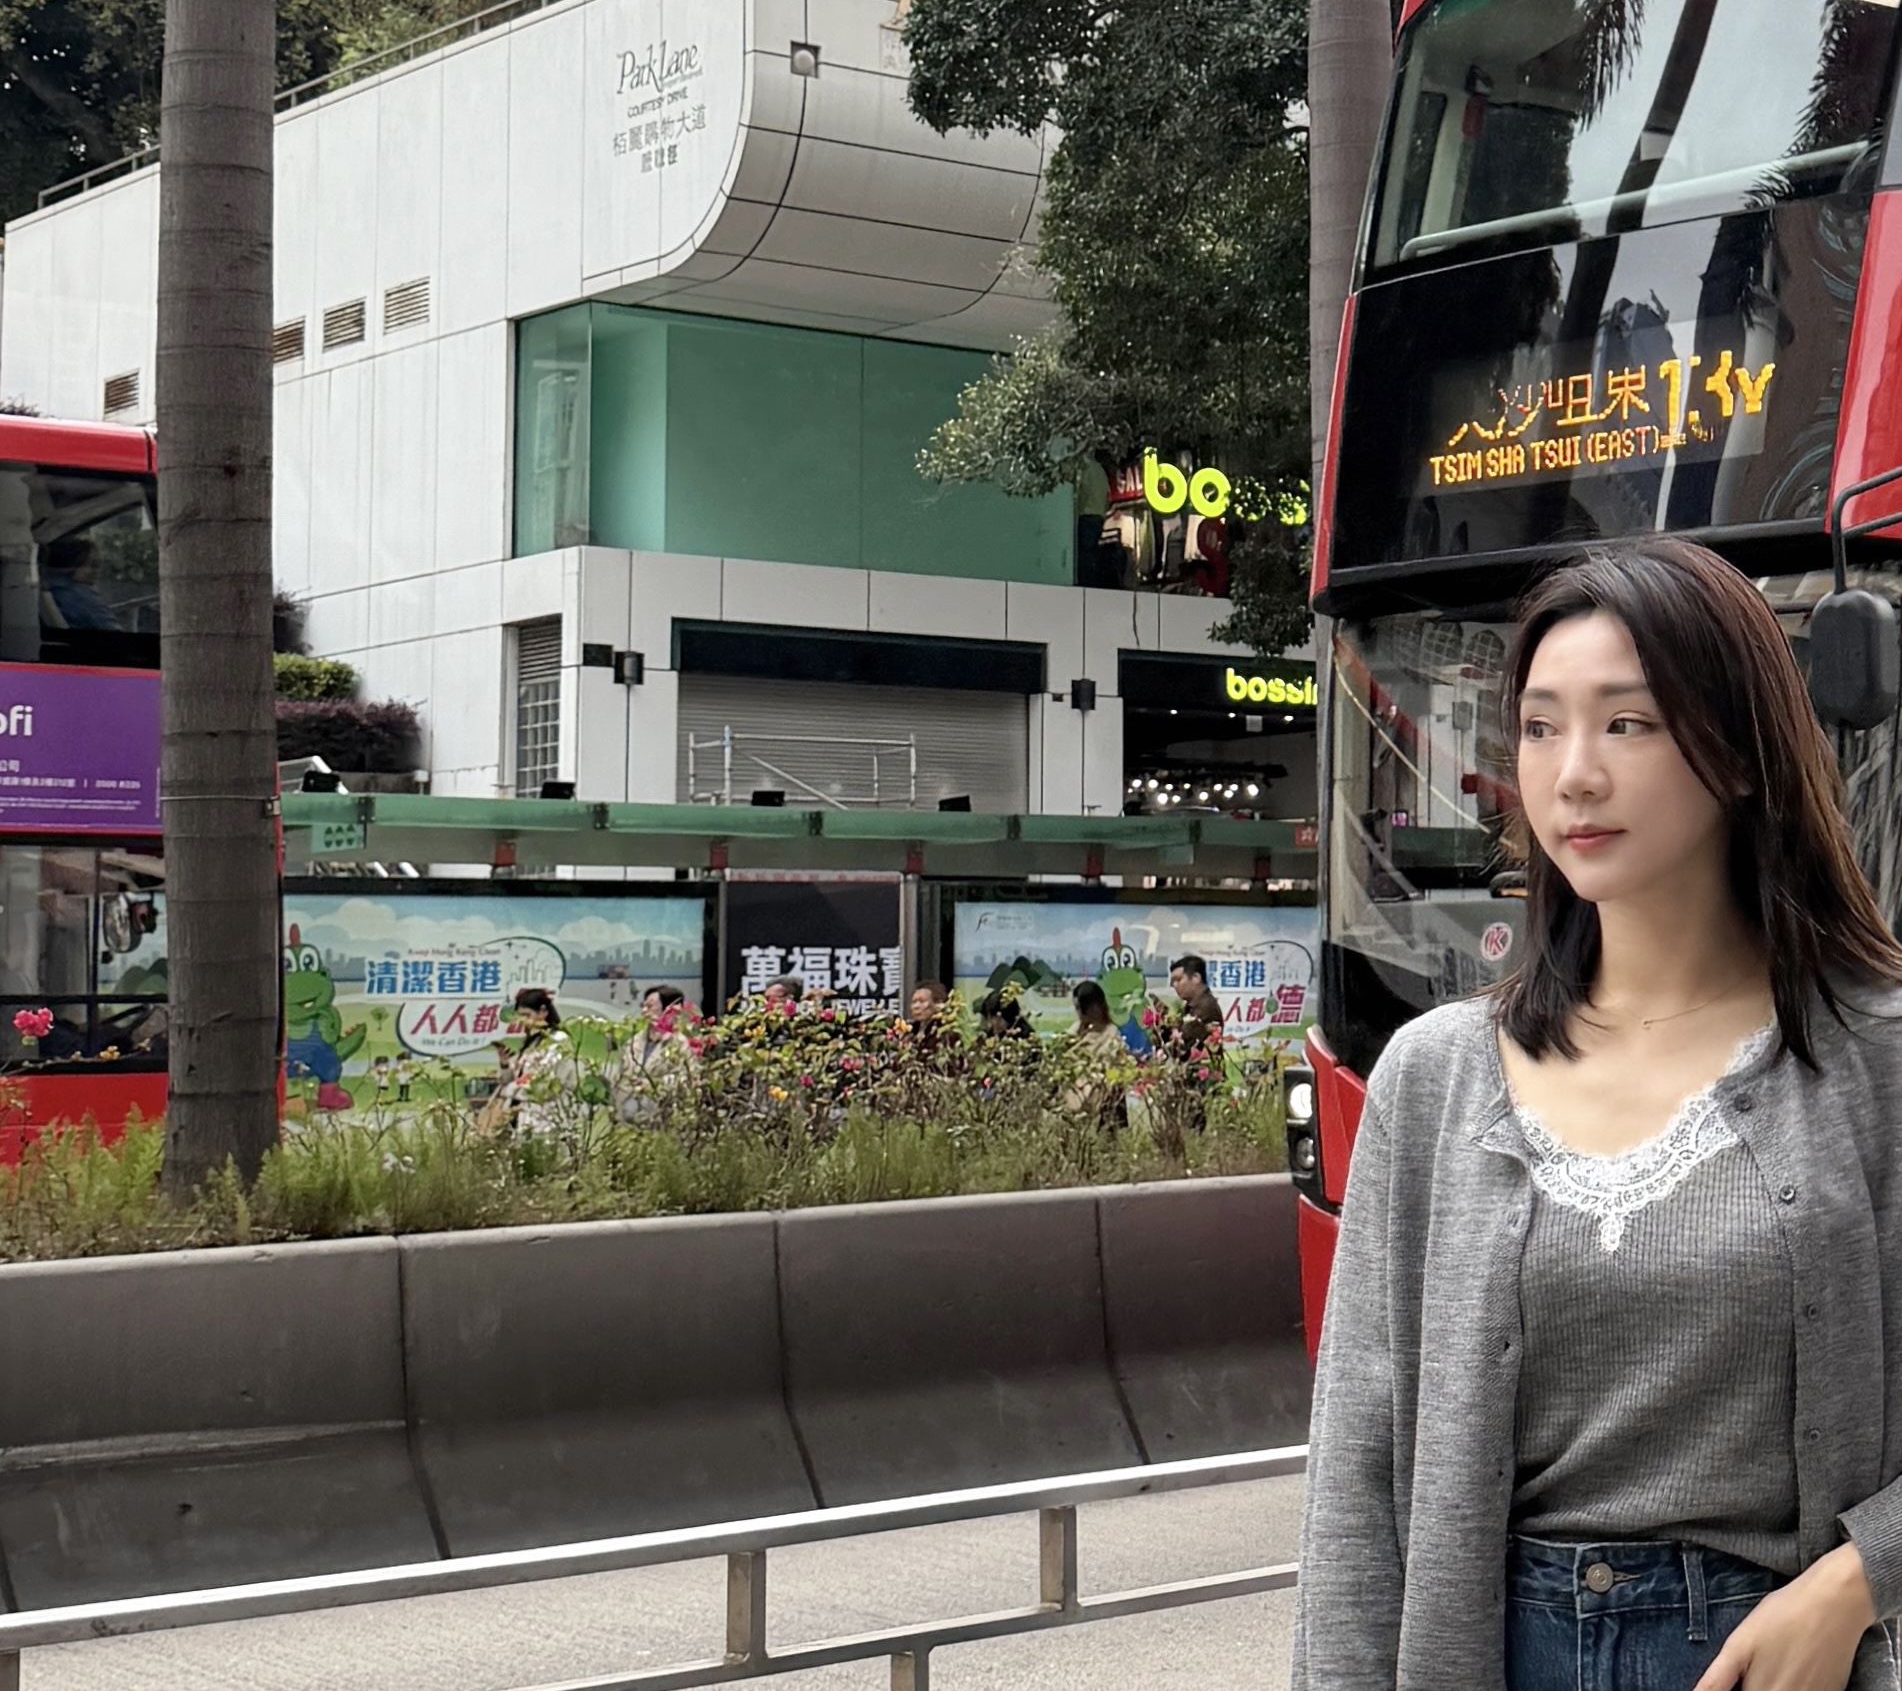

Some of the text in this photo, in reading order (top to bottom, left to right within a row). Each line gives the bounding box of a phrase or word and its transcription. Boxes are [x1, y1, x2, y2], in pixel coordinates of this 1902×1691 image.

[616, 44, 664, 94] Park
[658, 39, 698, 81] Lane
[1430, 425, 1660, 486] TSIM SHA TSUI (EAST)
[1116, 465, 1143, 494] SAL
[366, 959, 502, 995] 清潔香港
[1206, 959, 1266, 988] 香港
